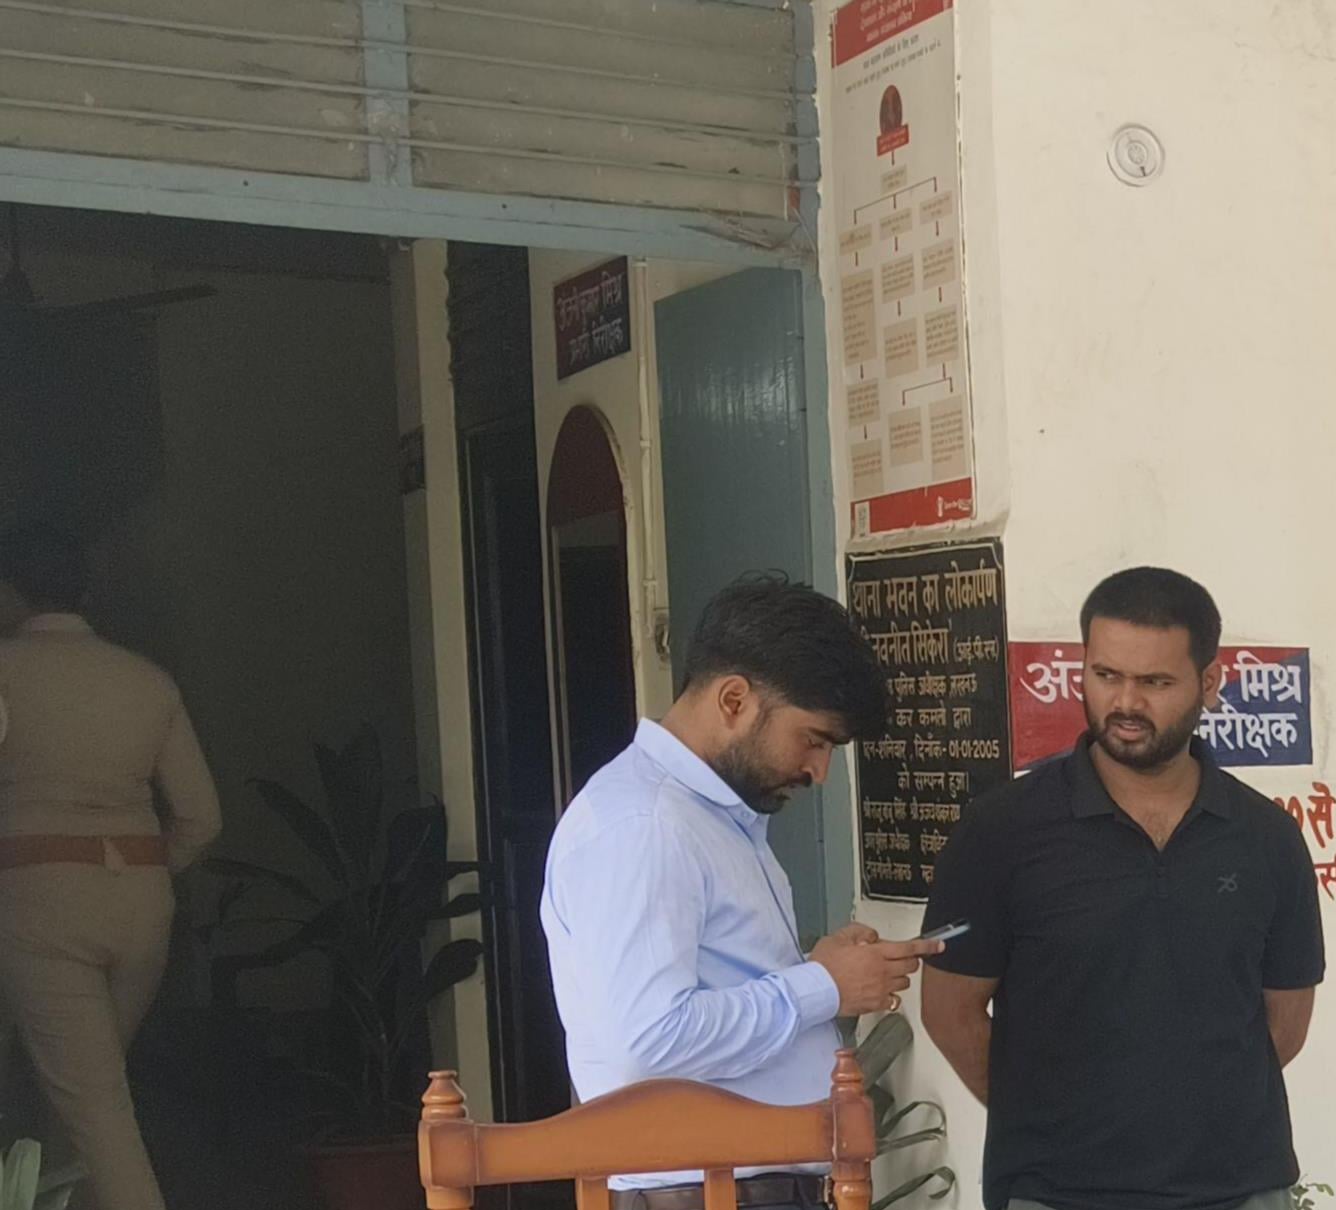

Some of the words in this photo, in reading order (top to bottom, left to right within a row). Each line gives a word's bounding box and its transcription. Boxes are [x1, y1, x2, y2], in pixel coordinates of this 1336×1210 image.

[853, 580, 881, 618] थाना
[883, 576, 918, 617] भवन
[921, 574, 940, 615] का
[944, 558, 998, 612] लोकार्पण
[871, 620, 911, 666] नवनीत
[1233, 650, 1301, 704] मिश्र
[896, 708, 913, 728] कर
[952, 707, 972, 730] द्वारा
[897, 762, 910, 791] को
